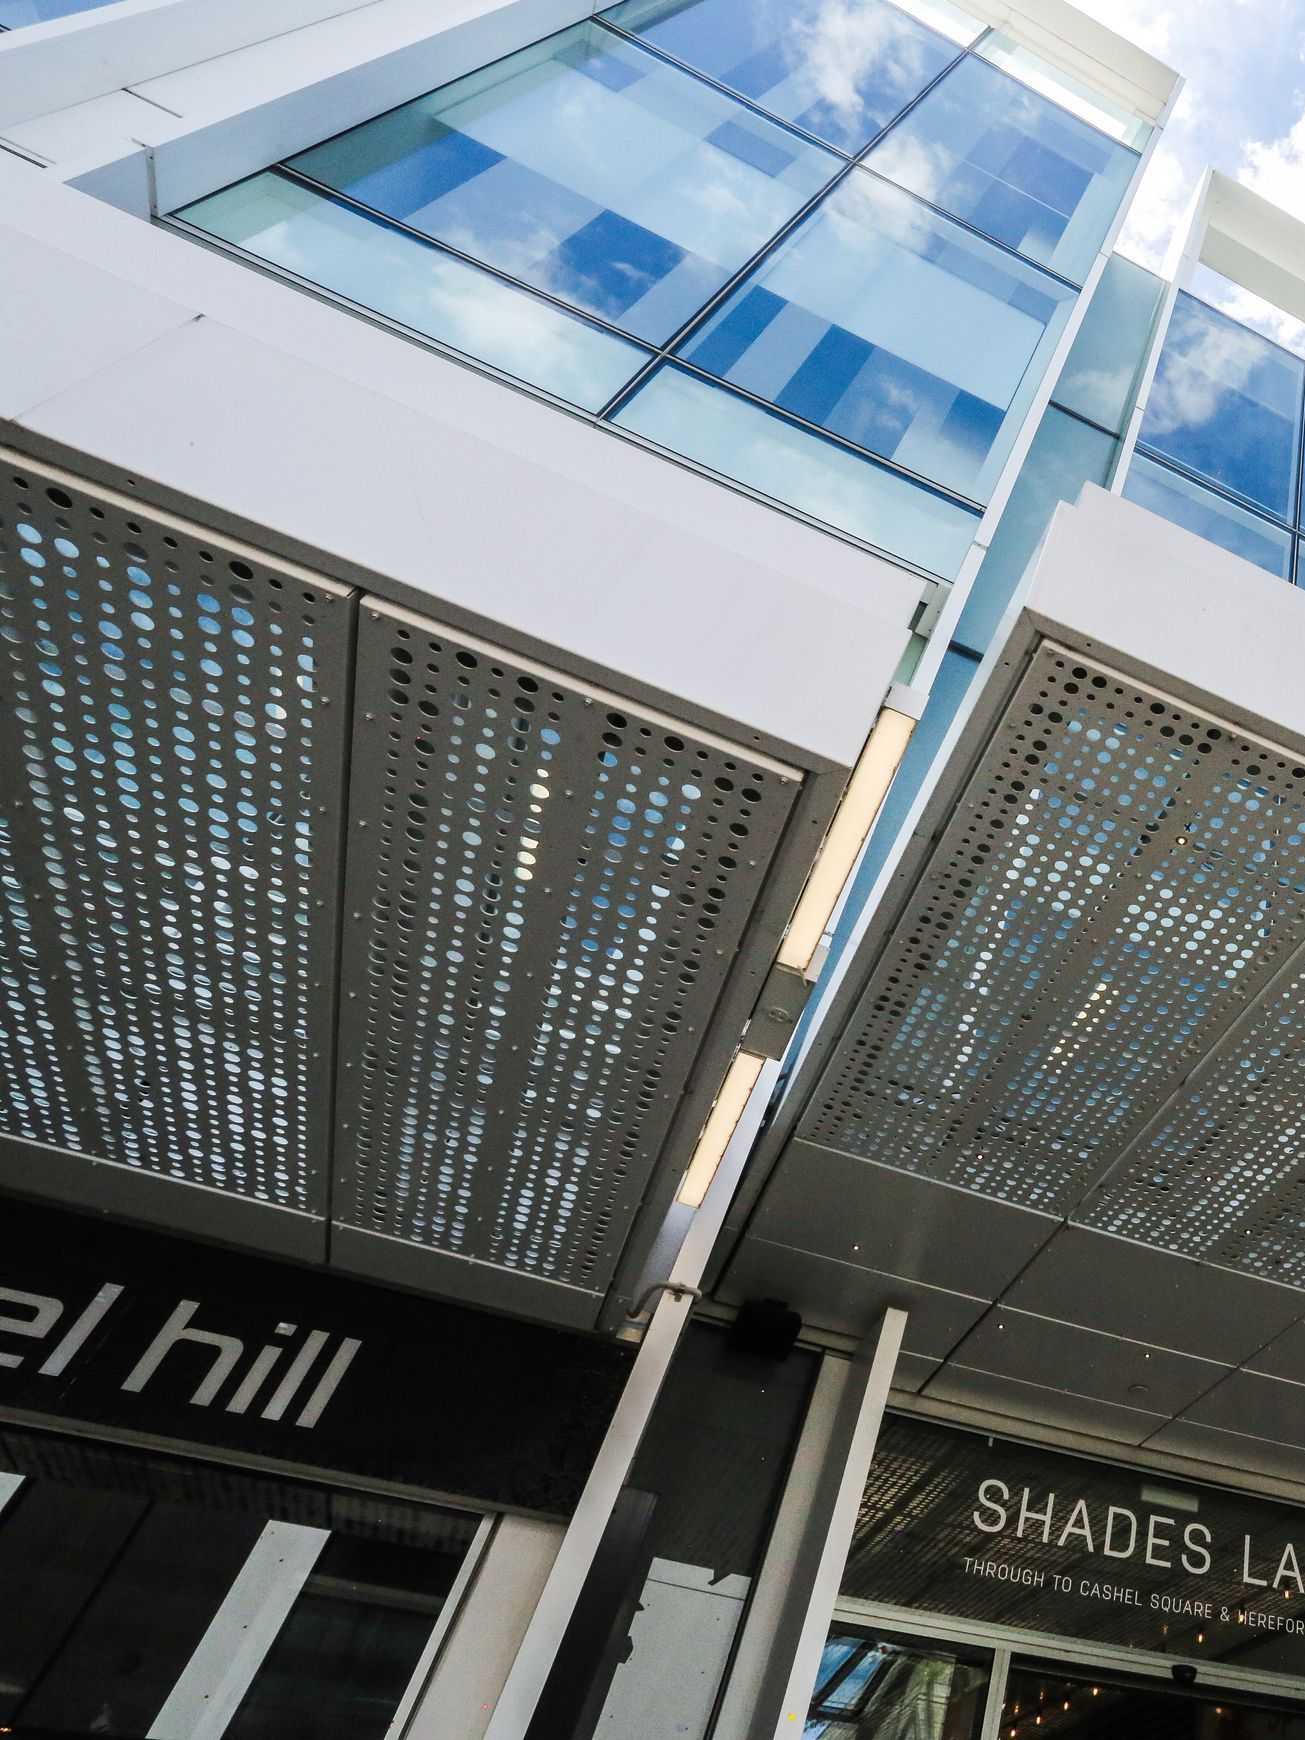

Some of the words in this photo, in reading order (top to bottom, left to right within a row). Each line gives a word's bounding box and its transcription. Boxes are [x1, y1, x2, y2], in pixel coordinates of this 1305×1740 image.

[120, 1299, 363, 1428] hill
[973, 1479, 1212, 1575] SHADES
[964, 1556, 1045, 1588] THROUGH
[1053, 1574, 1073, 1593] TO
[1079, 1580, 1143, 1606] CASHEL
[1150, 1593, 1213, 1619] SQUARE
[1220, 1606, 1230, 1622] &
